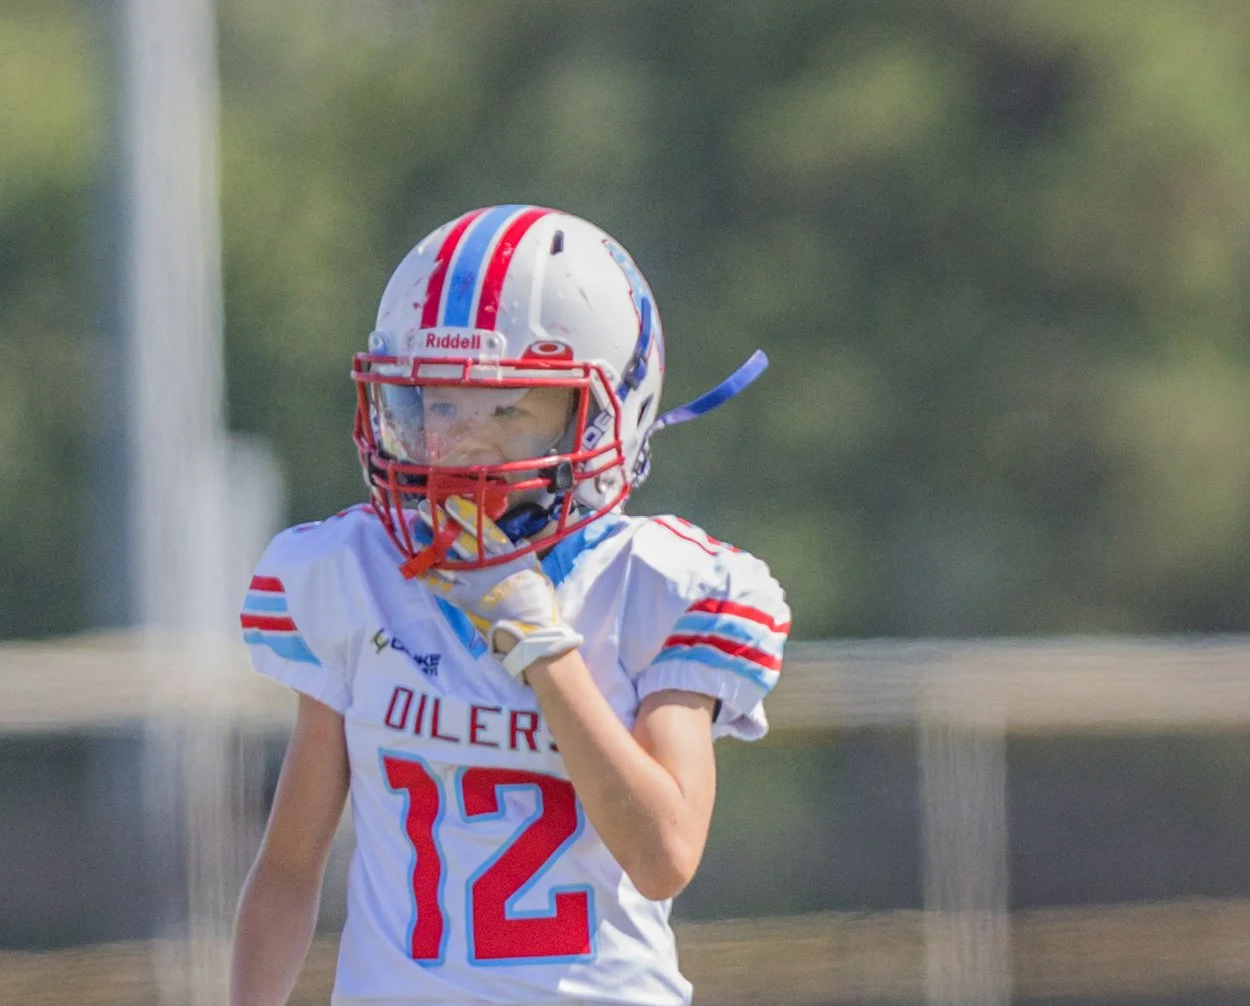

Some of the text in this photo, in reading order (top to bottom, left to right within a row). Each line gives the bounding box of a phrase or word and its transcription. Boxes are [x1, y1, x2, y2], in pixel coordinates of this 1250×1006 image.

[425, 333, 481, 350] Riddell
[384, 686, 559, 753] OILER
[378, 747, 598, 967] 12
